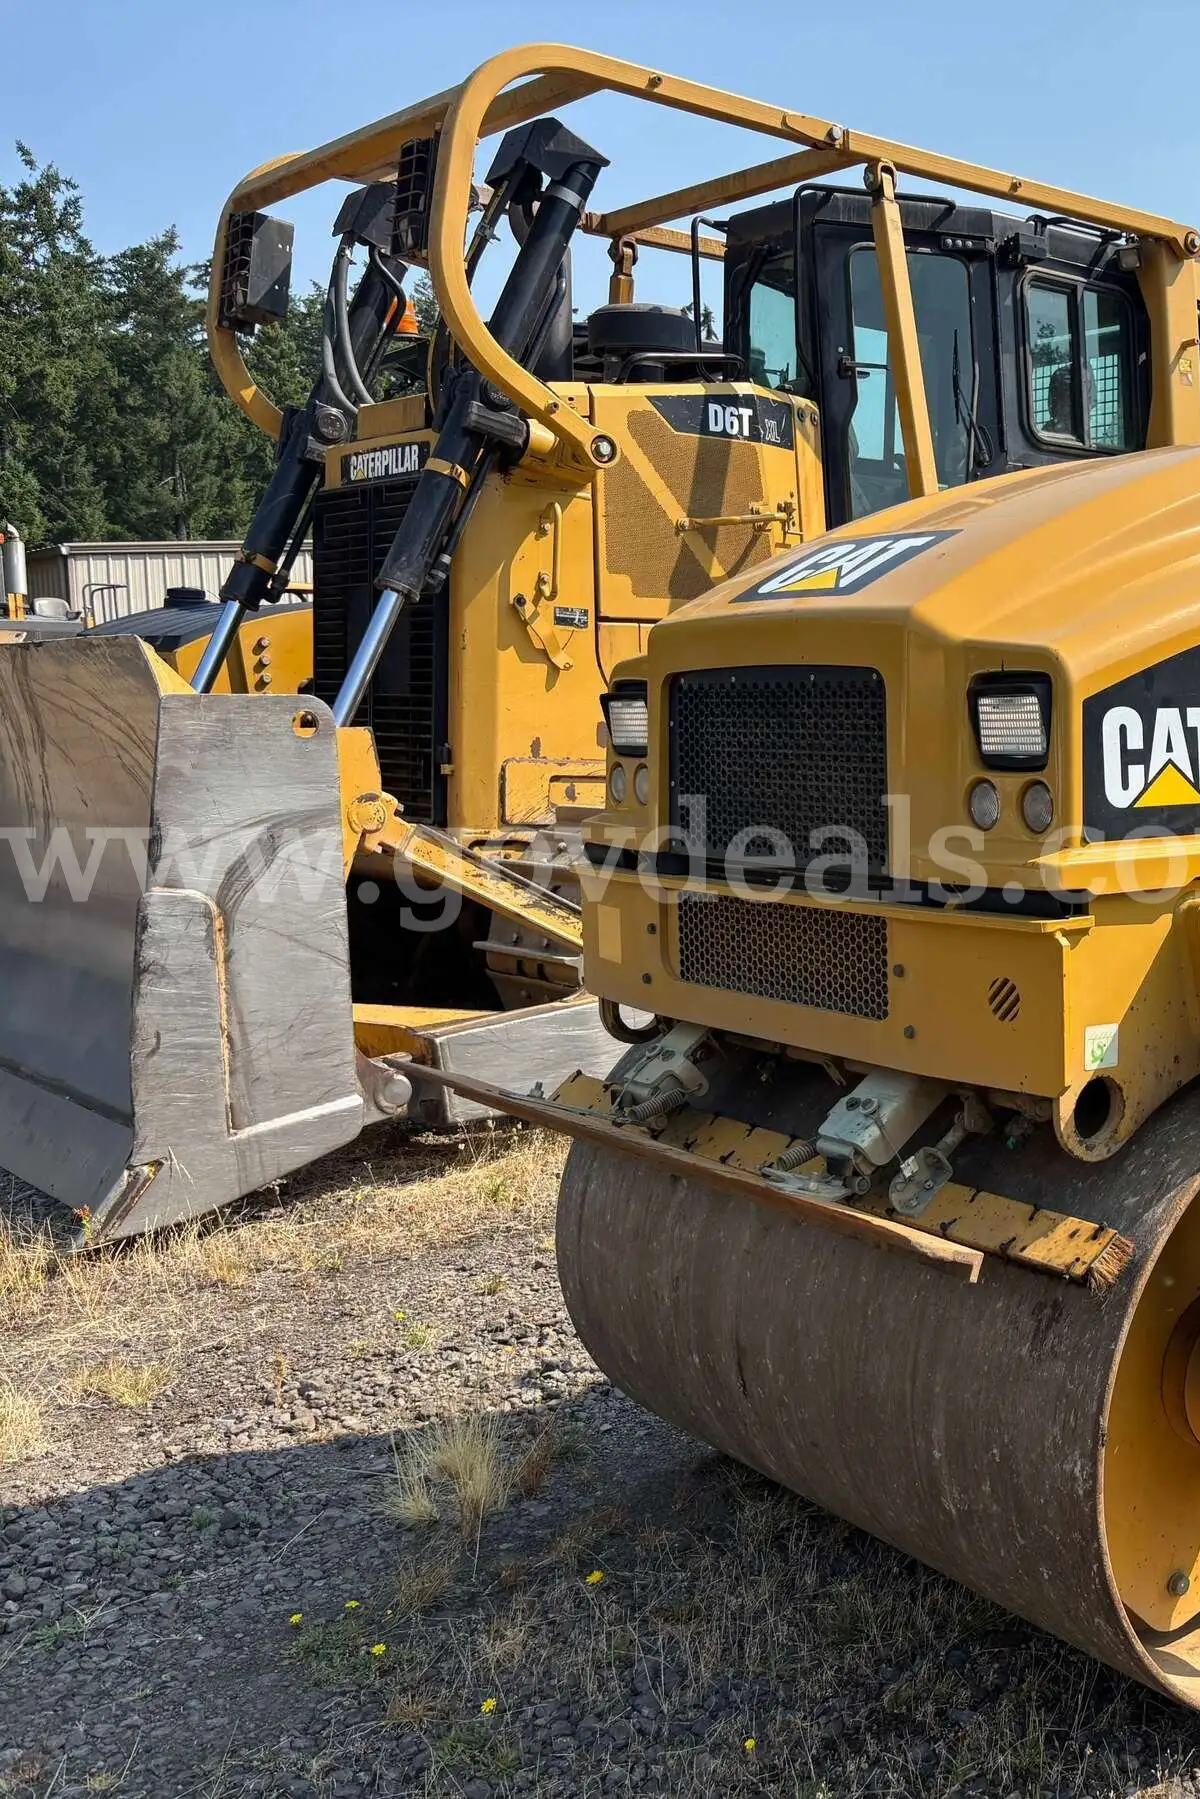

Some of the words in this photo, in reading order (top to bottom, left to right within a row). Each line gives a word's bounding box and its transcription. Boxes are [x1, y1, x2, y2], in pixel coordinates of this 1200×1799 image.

[708, 402, 753, 437] D6T
[349, 443, 419, 481] CATERPILLAR
[757, 535, 936, 594] CAT
